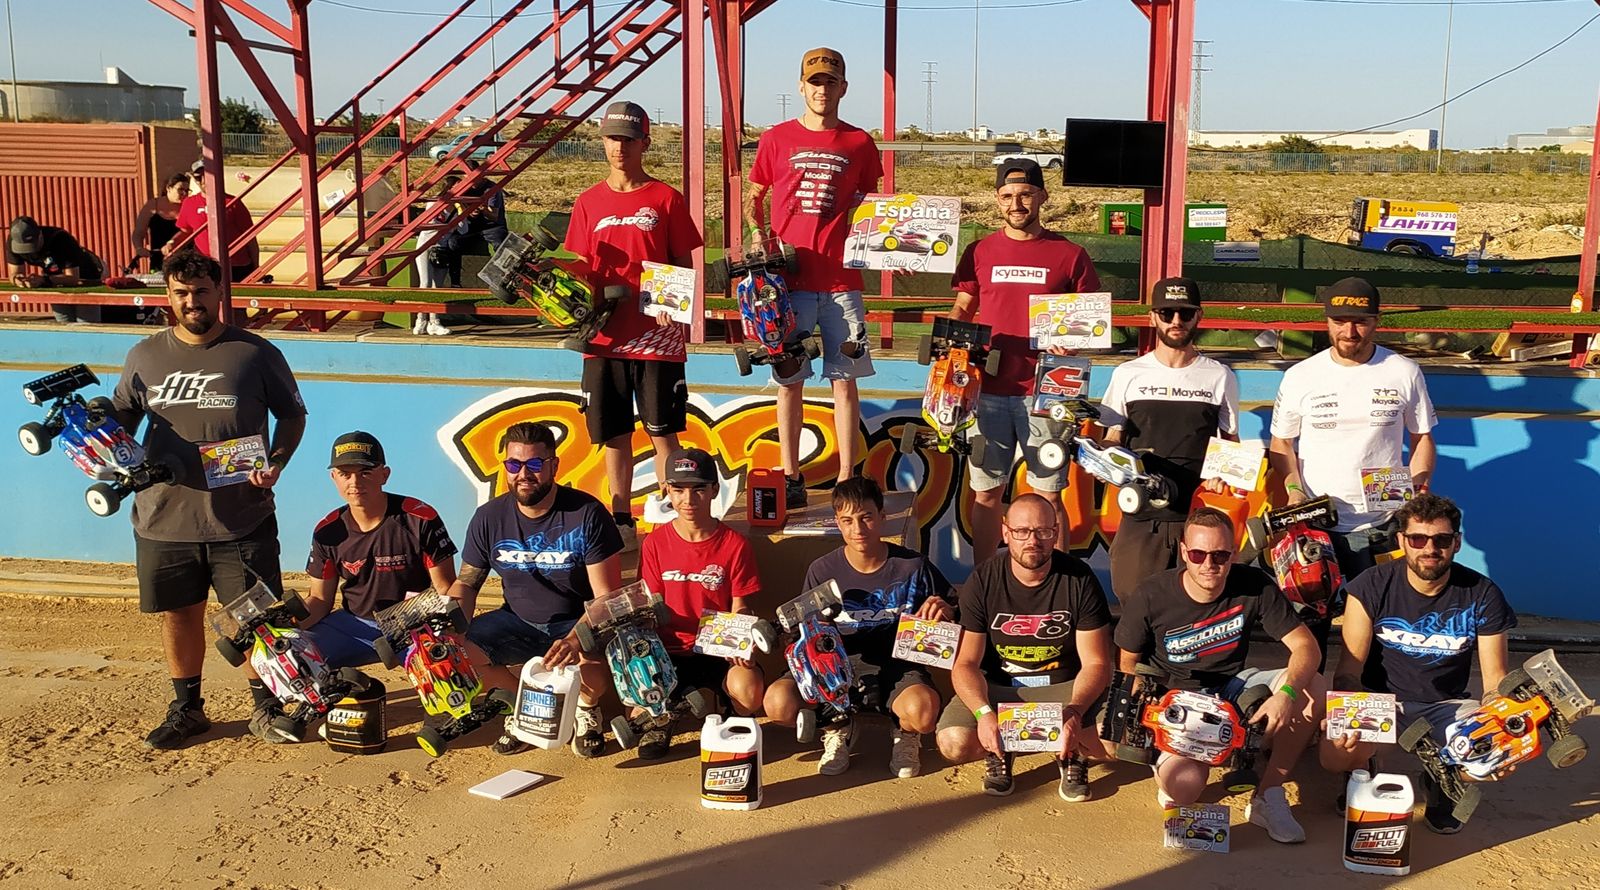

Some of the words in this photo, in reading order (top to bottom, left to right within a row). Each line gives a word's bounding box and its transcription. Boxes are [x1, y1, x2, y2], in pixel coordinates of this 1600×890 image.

[875, 201, 951, 221] España
[995, 269, 1042, 279] KYOSHO
[1048, 299, 1104, 313] España
[1172, 387, 1213, 399] Mayako
[199, 398, 237, 408] RACING
[496, 549, 574, 564] XRAY
[913, 620, 955, 638] España
[1375, 626, 1469, 650] XRAY
[523, 690, 557, 707] RUNNER
[1343, 697, 1390, 710] España
[1013, 708, 1057, 720] España
[708, 767, 748, 780] SHOOT
[724, 776, 744, 784] FUEL
[1180, 807, 1225, 820] España
[1358, 828, 1406, 841] SHOOT
[1375, 839, 1400, 847] FUEL
